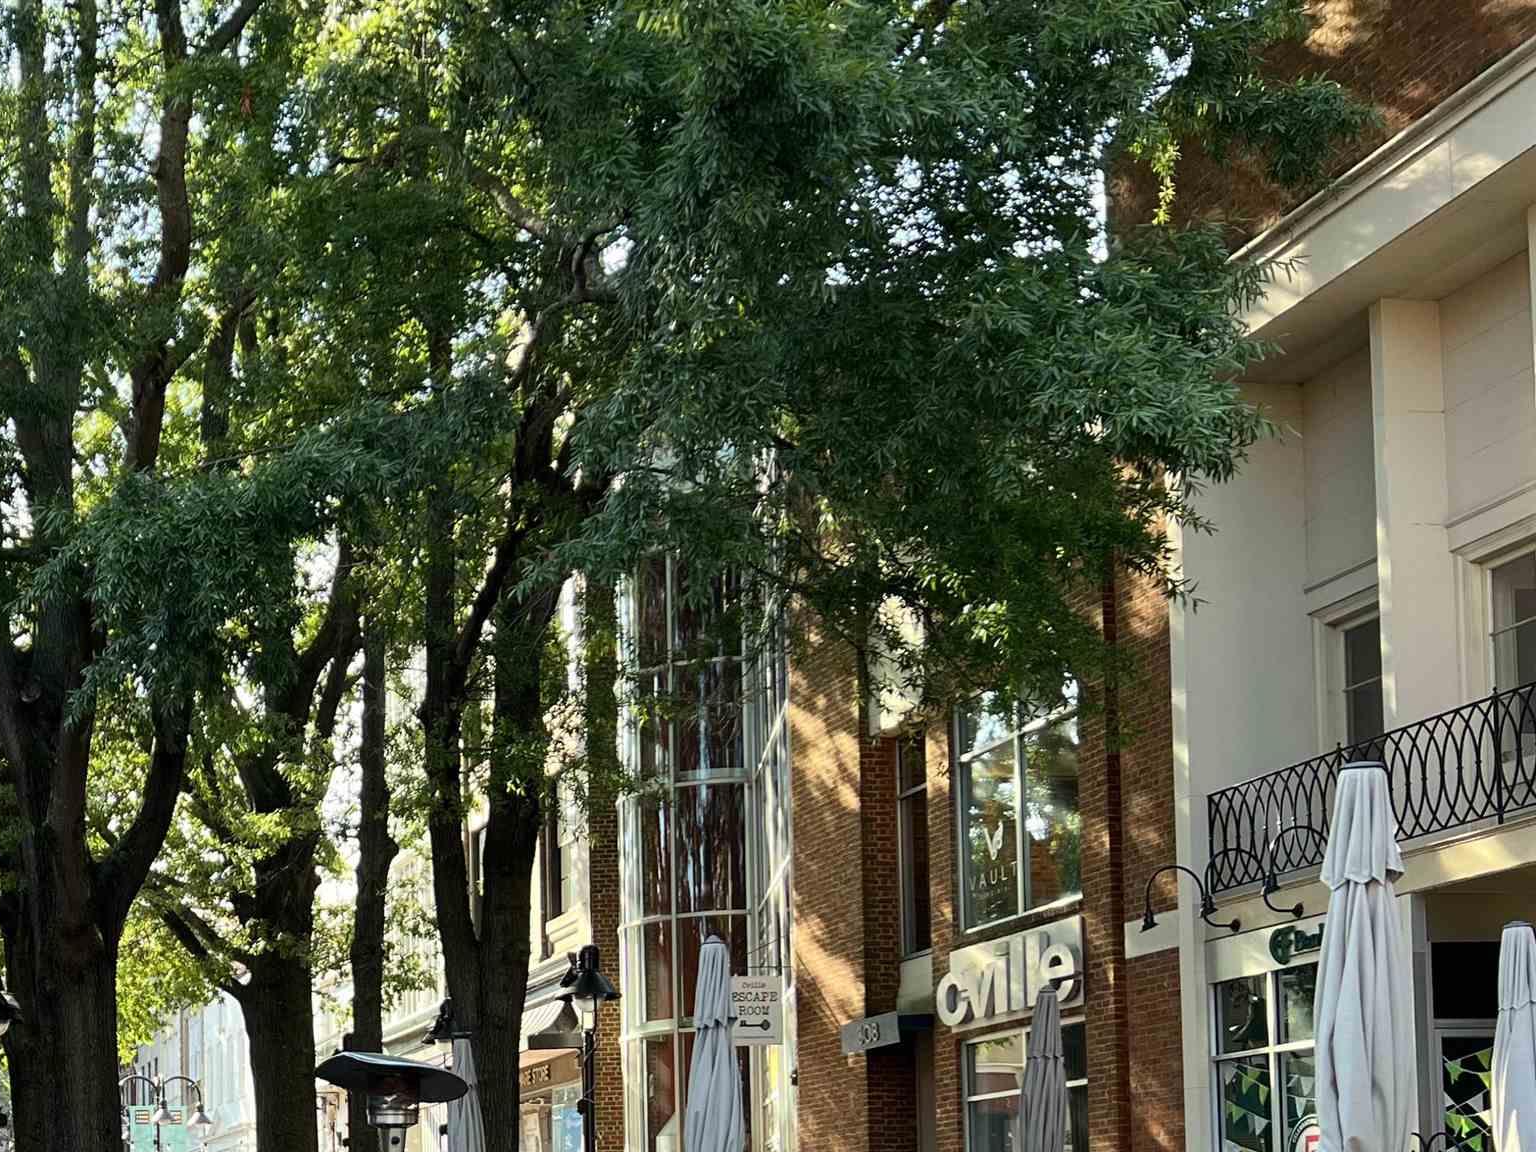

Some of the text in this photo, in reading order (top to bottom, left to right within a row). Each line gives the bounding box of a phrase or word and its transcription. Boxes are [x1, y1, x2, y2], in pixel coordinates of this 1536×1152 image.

[969, 861, 1017, 891] VAULT
[731, 992, 778, 1002] ESCAPE
[738, 1006, 770, 1016] ROOM
